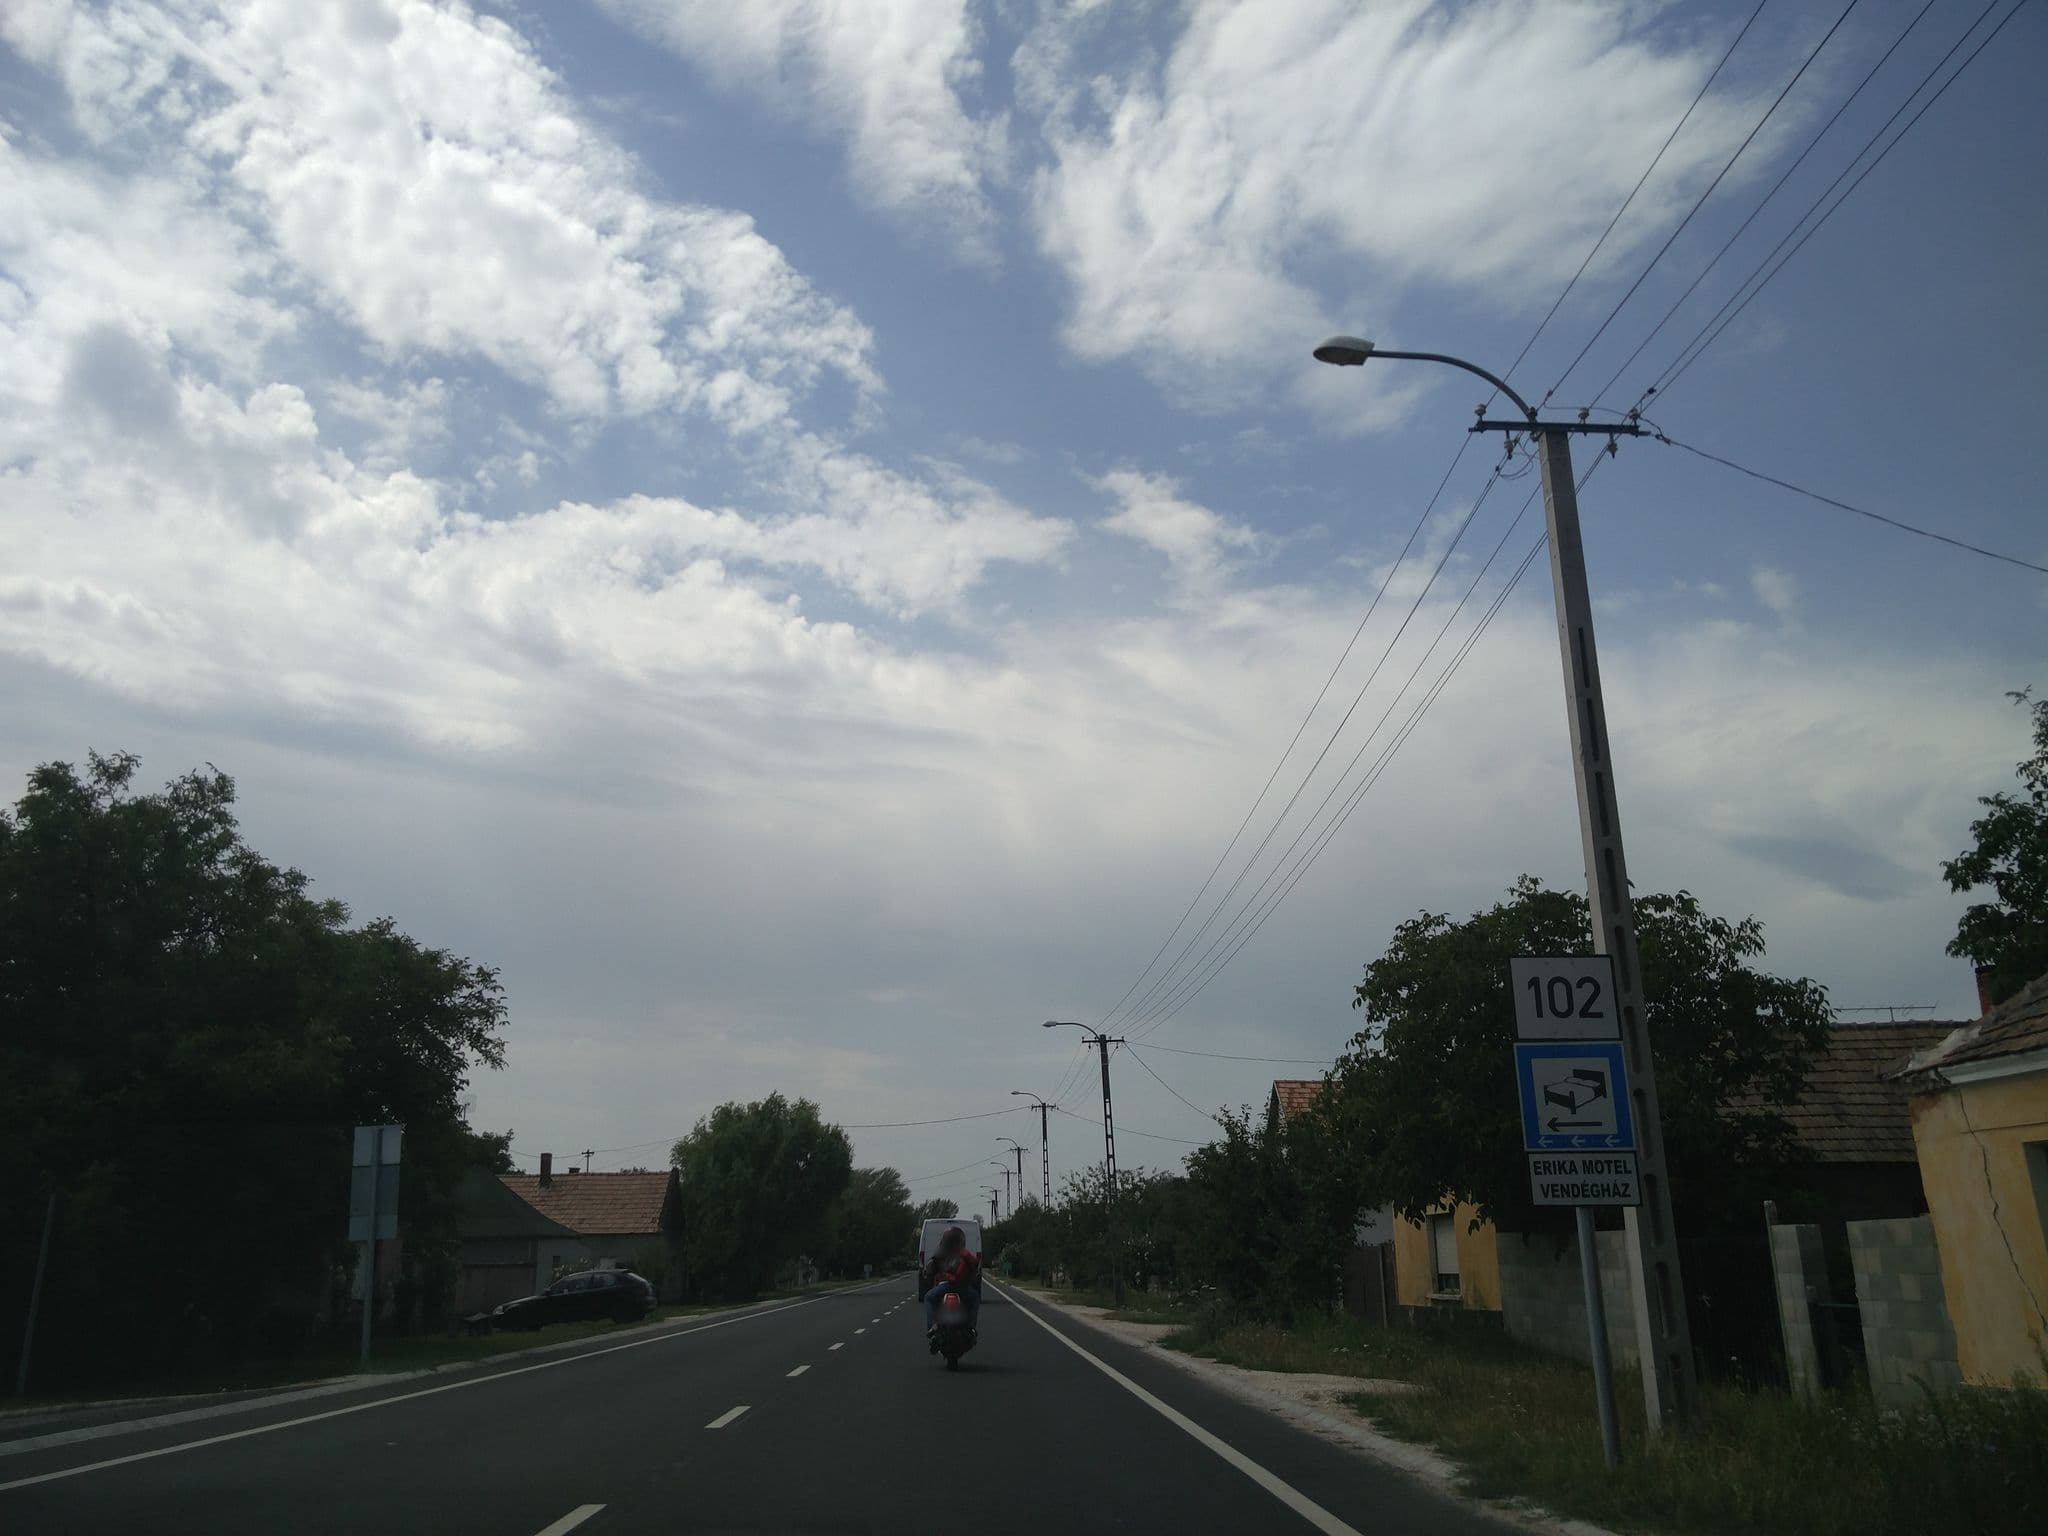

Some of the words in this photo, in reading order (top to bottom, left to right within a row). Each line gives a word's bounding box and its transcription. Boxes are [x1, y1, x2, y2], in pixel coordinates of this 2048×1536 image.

[1527, 976, 1604, 1019] 102
[1533, 1160, 1579, 1176] ERIKA
[1582, 1159, 1632, 1175] MOTEL
[1540, 1180, 1631, 1199] VENDÉGHÁZ
